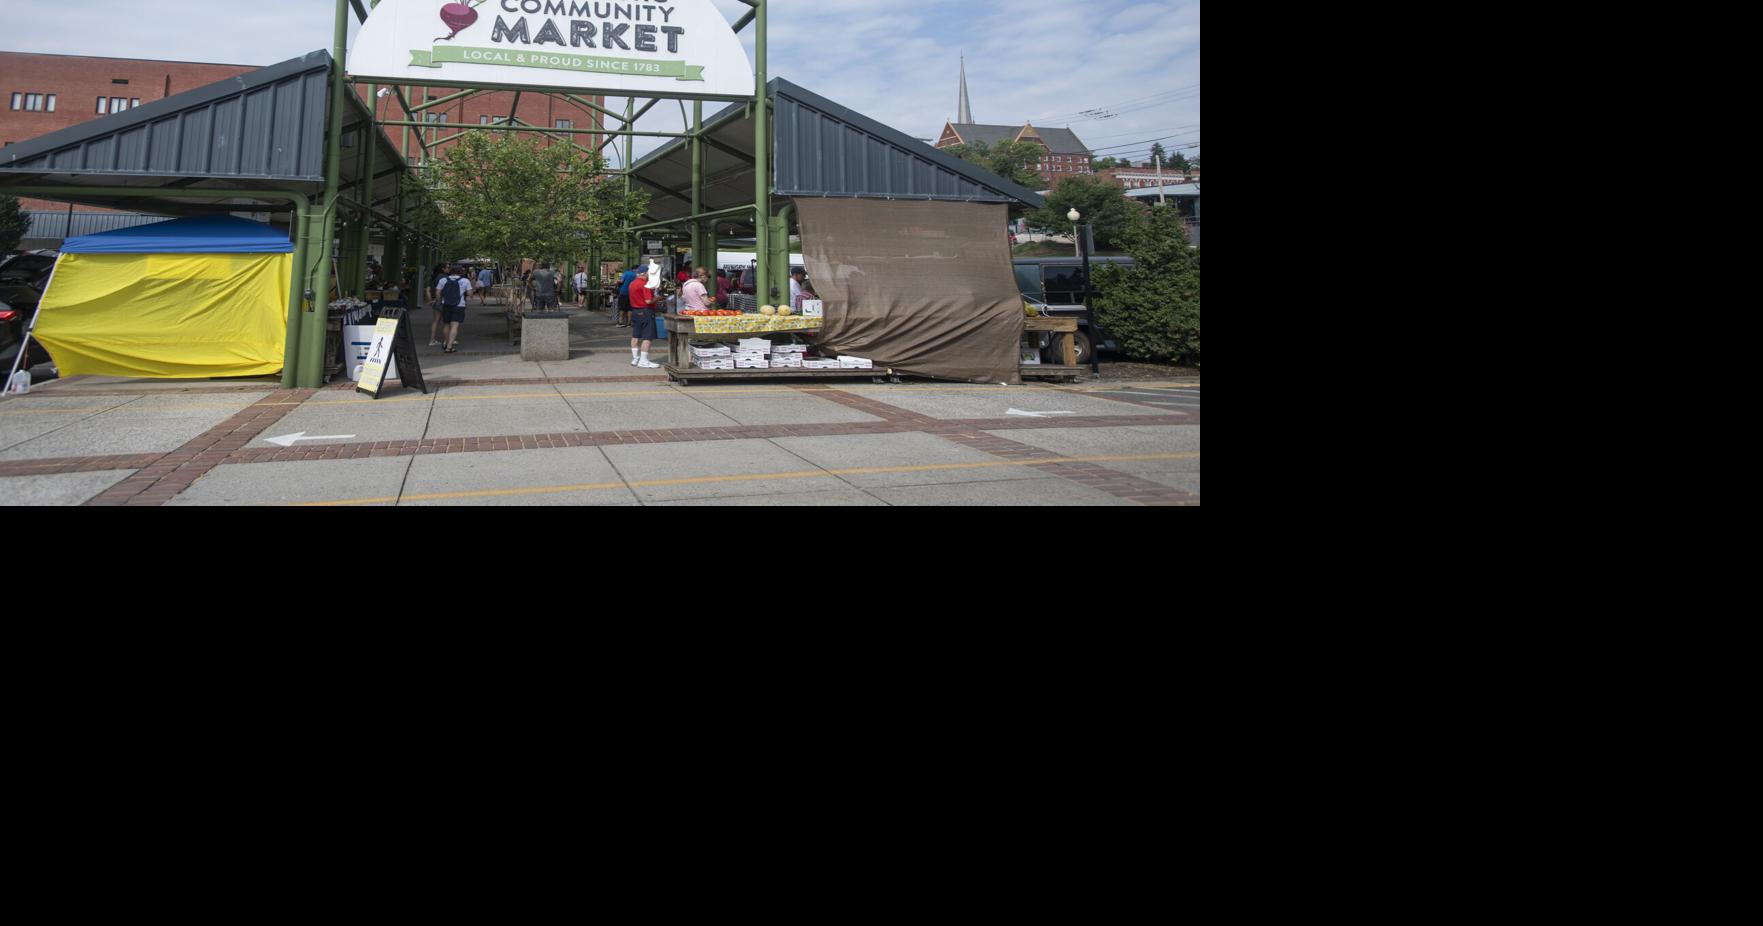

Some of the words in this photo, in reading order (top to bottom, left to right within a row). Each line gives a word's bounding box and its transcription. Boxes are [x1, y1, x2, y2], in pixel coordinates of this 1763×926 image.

[501, 0, 675, 23] COMMUNITY
[491, 14, 685, 54] MARKET
[463, 50, 511, 62] LOCAL
[516, 53, 526, 63] &
[530, 55, 581, 67] PROUD
[586, 59, 629, 71] SINCE
[634, 62, 660, 73] 1783
